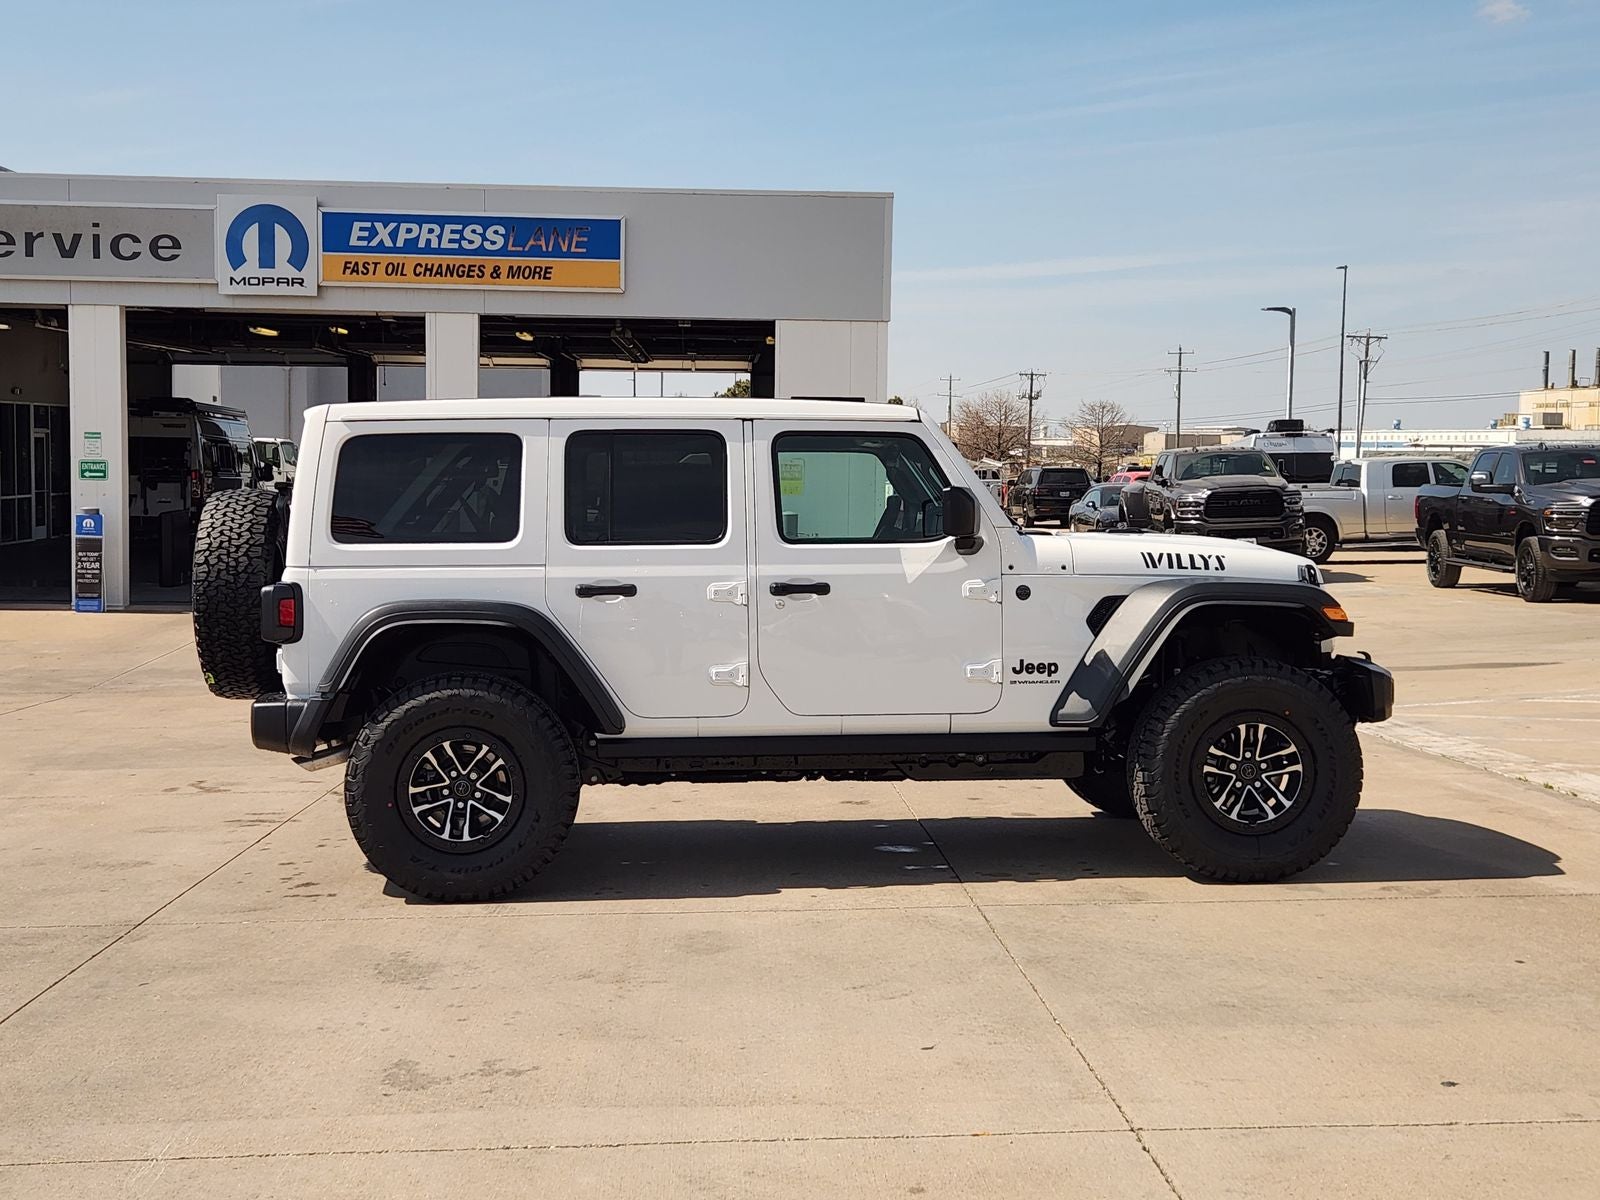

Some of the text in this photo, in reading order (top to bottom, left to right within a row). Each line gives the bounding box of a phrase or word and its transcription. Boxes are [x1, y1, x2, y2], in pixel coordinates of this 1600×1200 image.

[342, 261, 554, 280] FAST OIL CHANGES & MORE
[229, 276, 305, 287] MOPAR
[1140, 552, 1226, 571] WILLYS
[1012, 659, 1059, 677] Jeep
